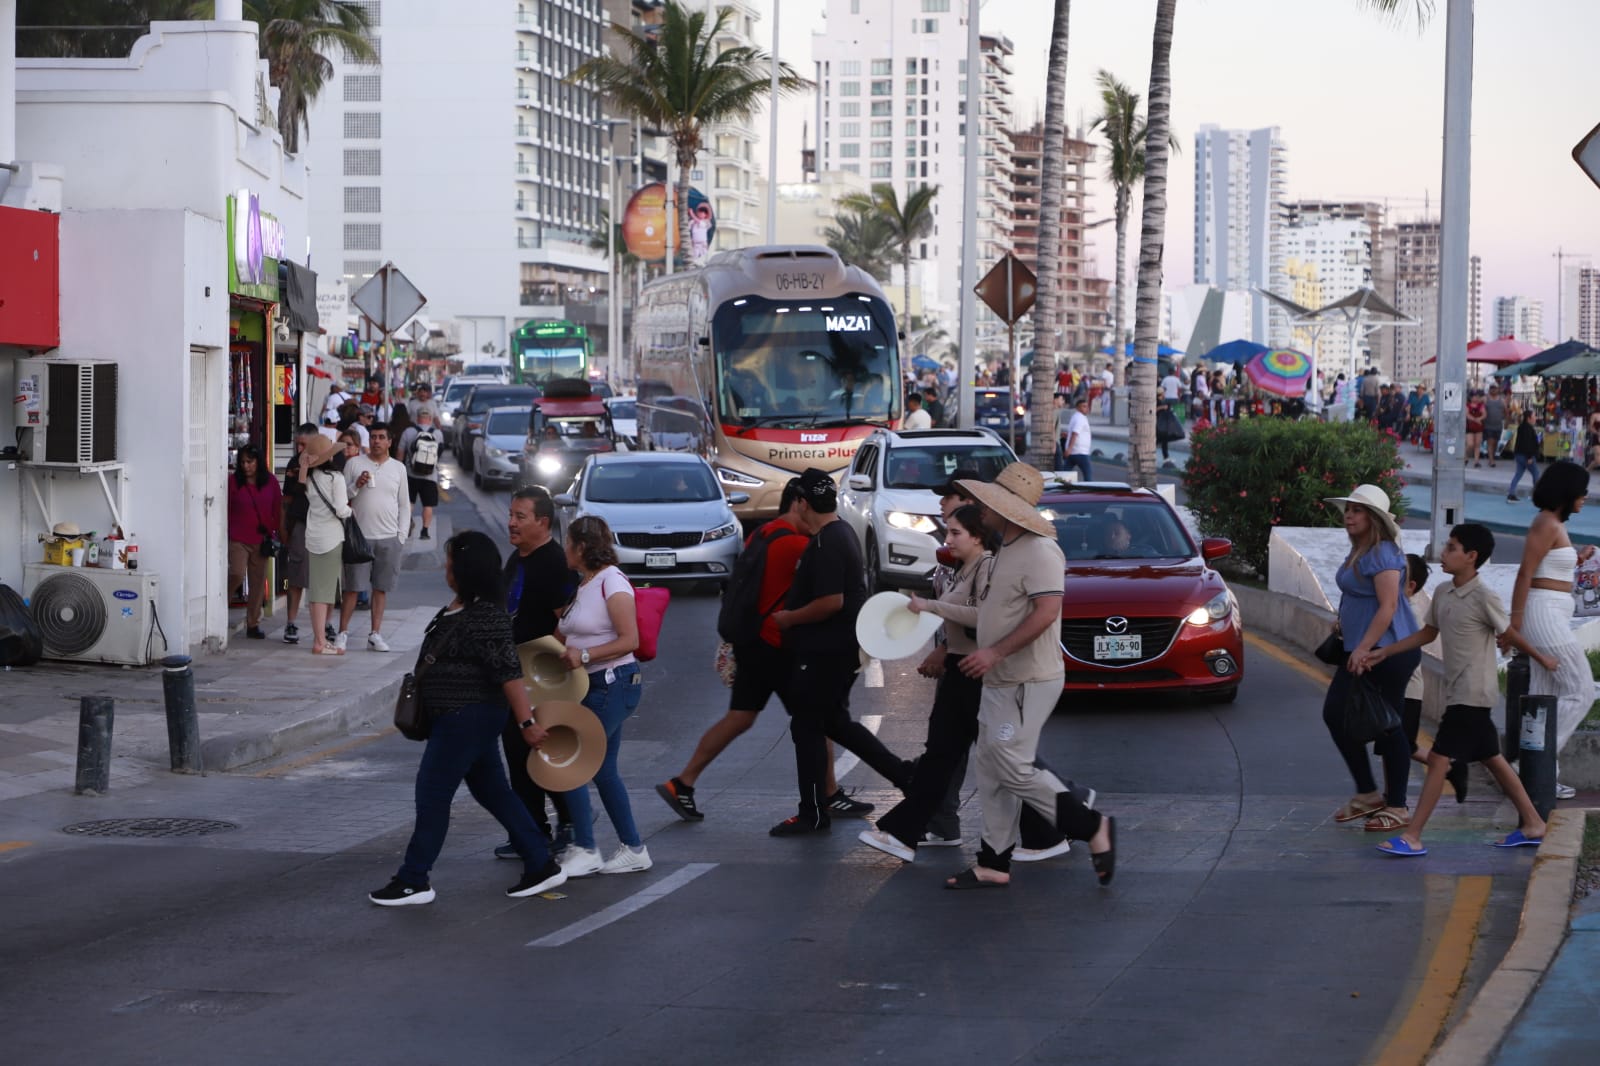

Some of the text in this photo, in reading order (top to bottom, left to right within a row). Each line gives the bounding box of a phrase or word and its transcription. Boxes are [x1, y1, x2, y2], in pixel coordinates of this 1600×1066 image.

[776, 272, 825, 291] 06-HB-2Y
[769, 447, 857, 459] Primera Plus
[1096, 641, 1140, 653] JLX-36-90
